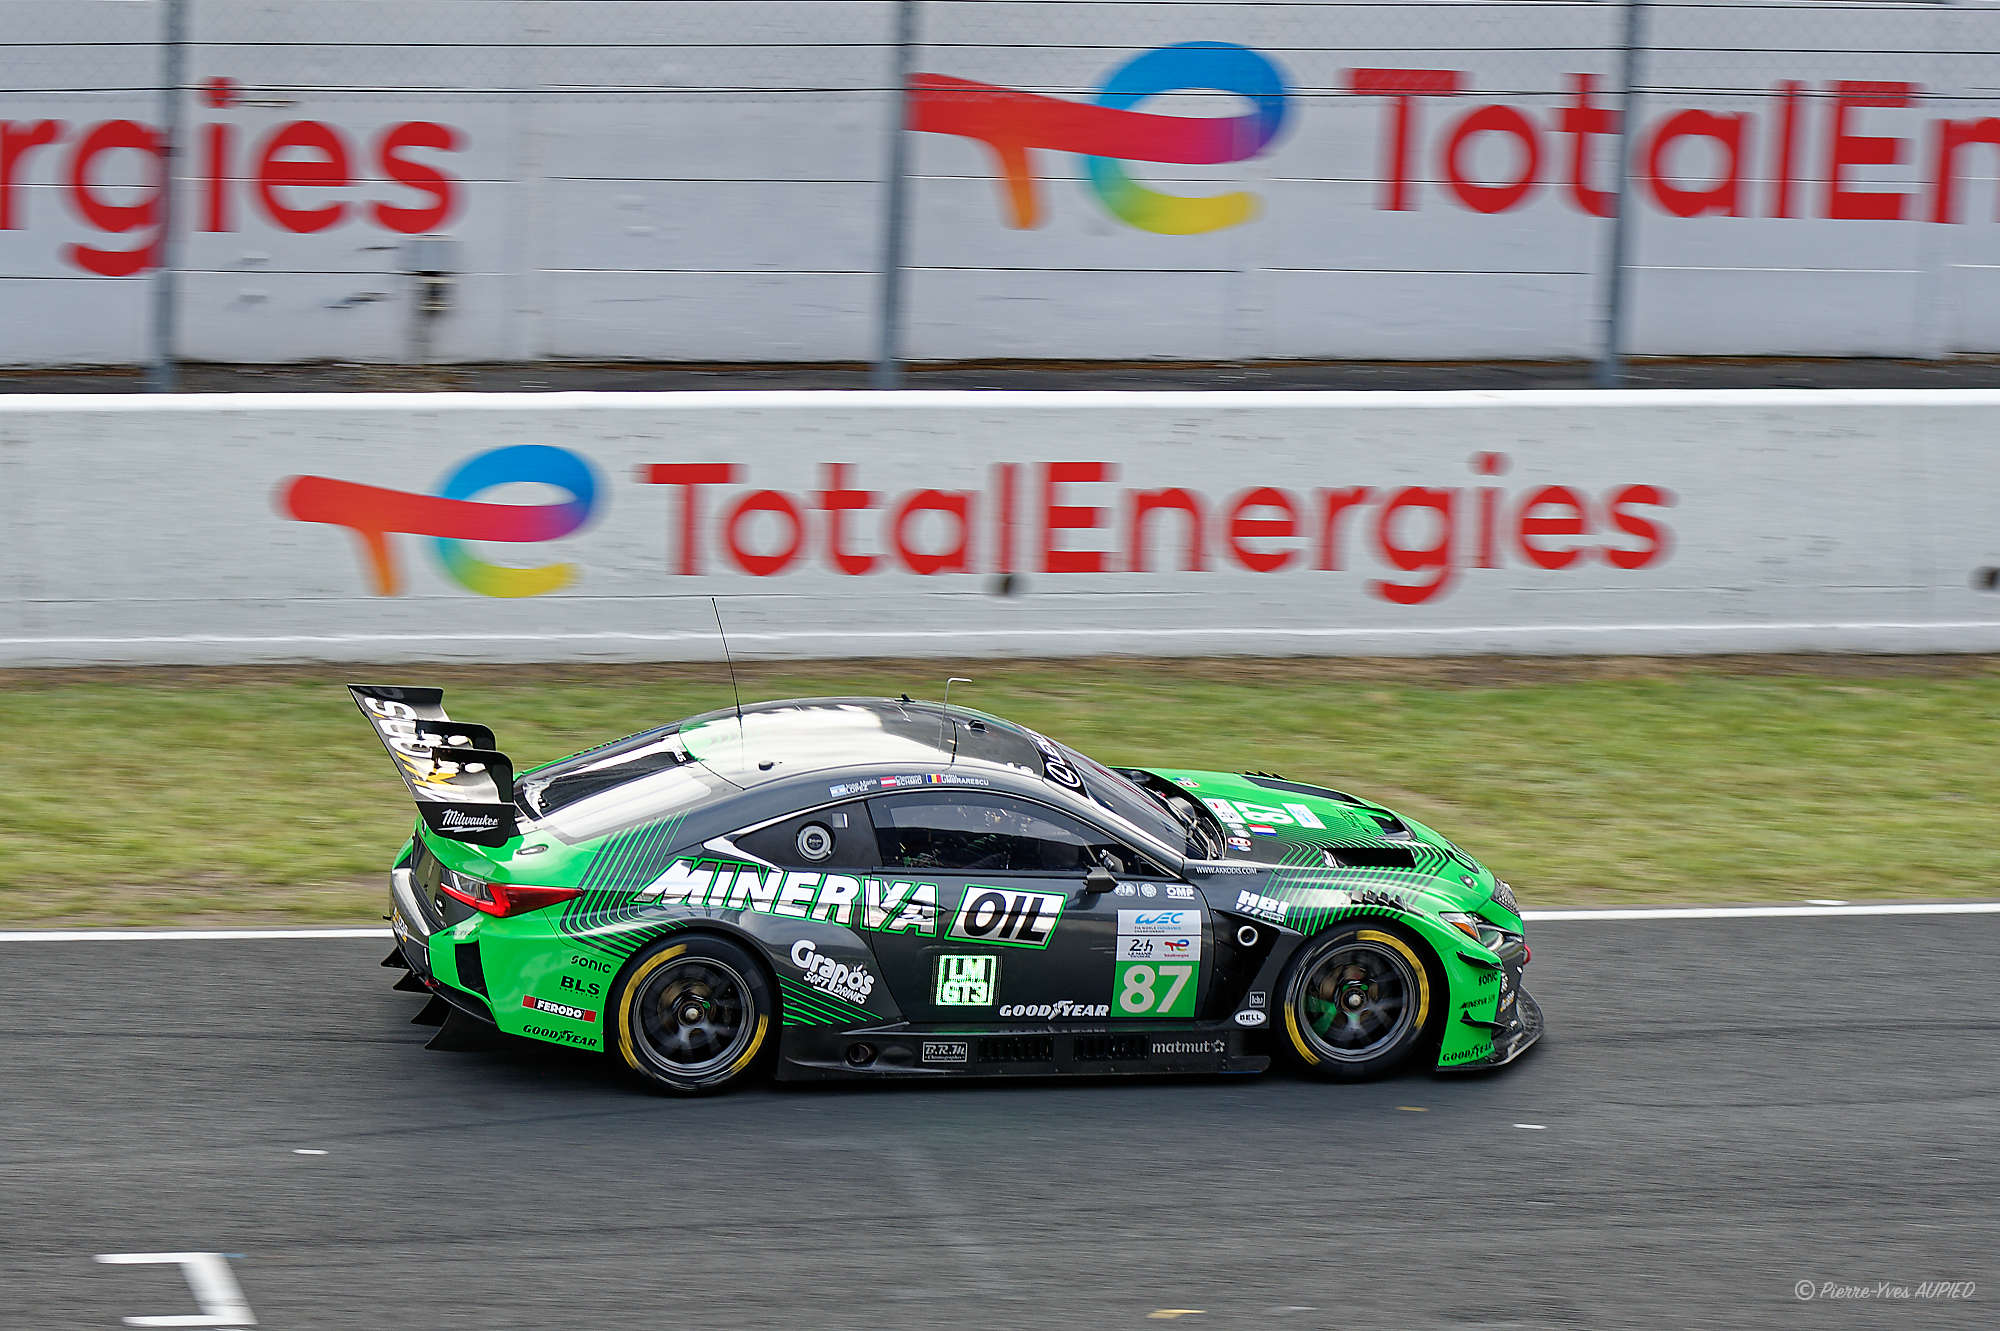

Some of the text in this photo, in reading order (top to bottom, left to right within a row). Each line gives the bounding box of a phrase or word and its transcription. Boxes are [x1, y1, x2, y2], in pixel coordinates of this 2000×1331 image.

[0, 77, 467, 277] rgies
[638, 451, 1674, 605] TotalEnergies
[442, 809, 500, 827] Milwaukee
[629, 857, 1051, 944] MINERVA OIL
[1166, 887, 1194, 897] OMP
[1135, 912, 1185, 925] WEC
[560, 975, 601, 996] BLS
[803, 971, 830, 988] SOFT
[1118, 964, 1194, 1014] 87
[833, 984, 868, 1005] DRINKS
[536, 999, 583, 1019] FERODO
[999, 1000, 1110, 1020] GOODYEAR
[522, 1024, 599, 1047] GOODYEAR
[1152, 1040, 1210, 1054] matmut
